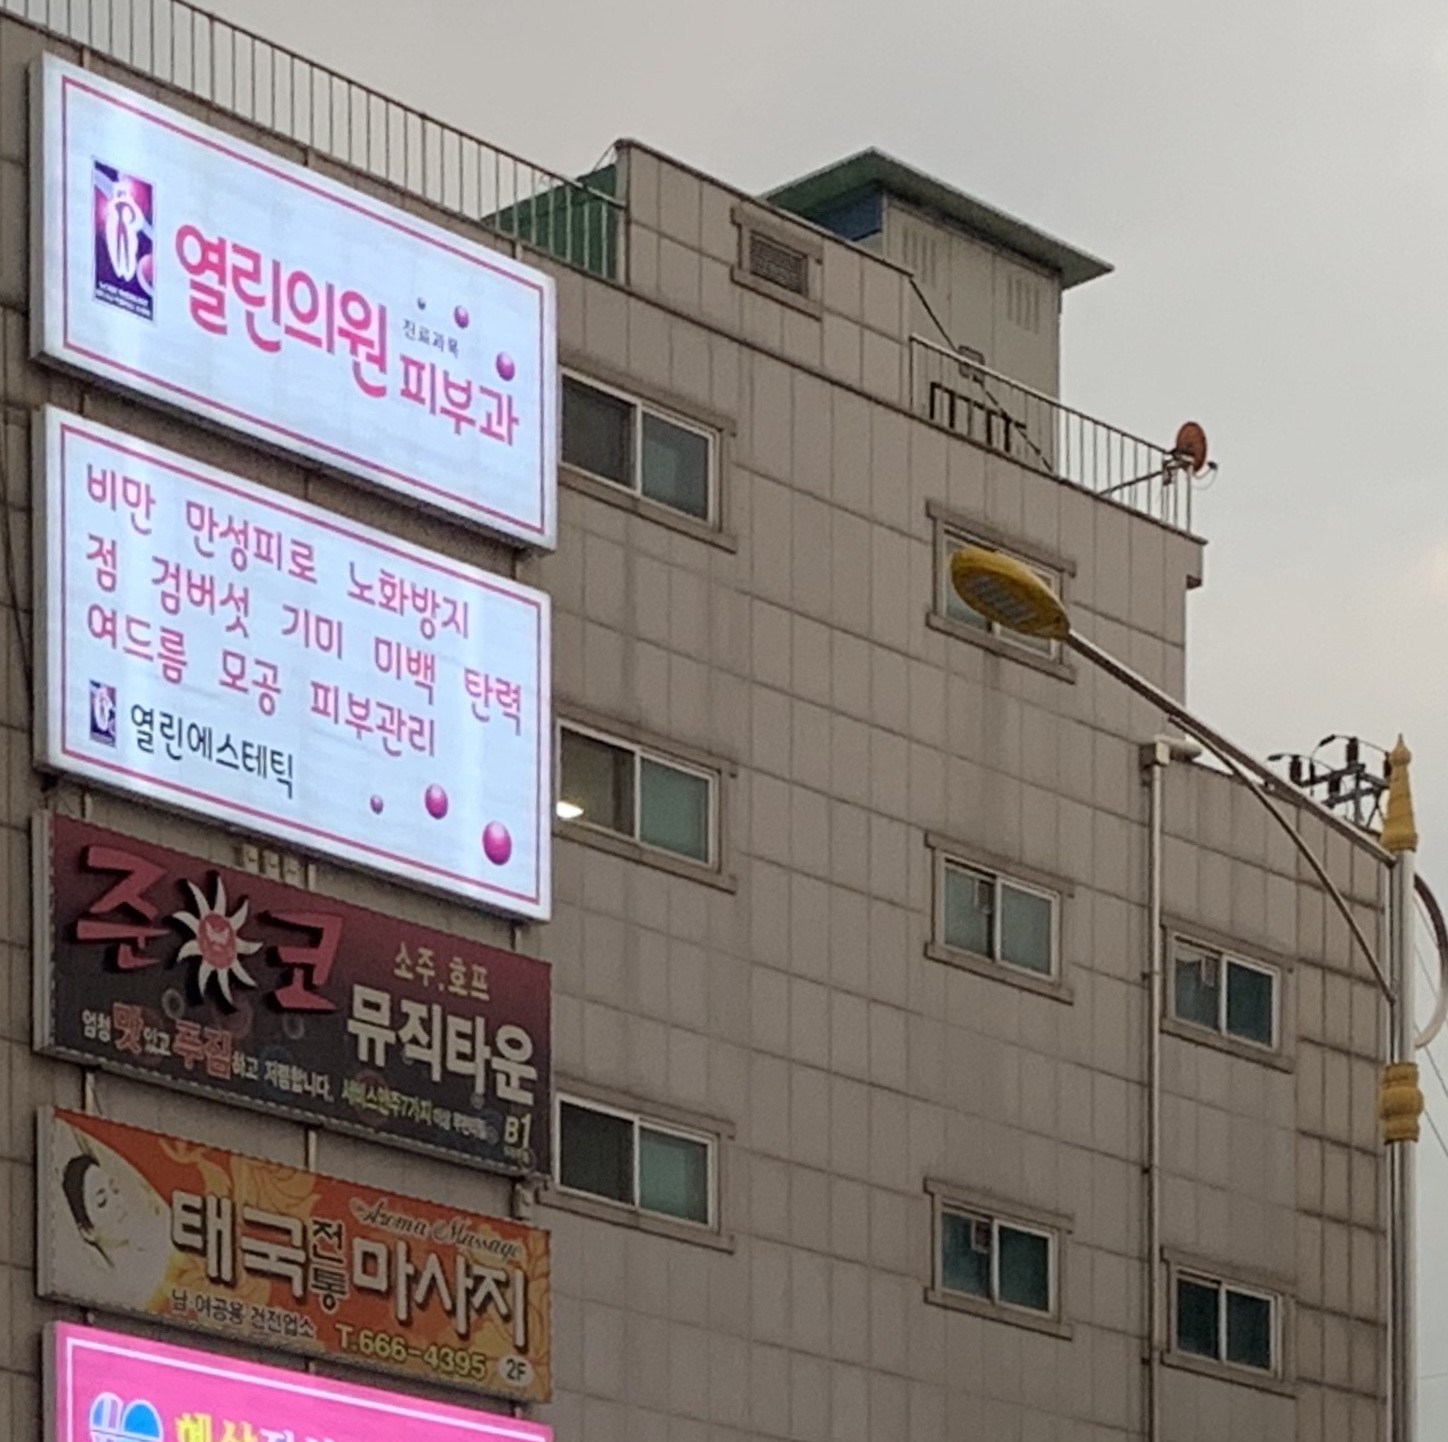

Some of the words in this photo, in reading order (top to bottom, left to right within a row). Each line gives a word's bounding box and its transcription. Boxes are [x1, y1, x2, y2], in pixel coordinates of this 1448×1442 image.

[175, 223, 388, 398] 열린의원
[402, 319, 460, 359] 진료과목
[400, 354, 519, 447] 피부과
[87, 463, 156, 536] 비만
[186, 500, 317, 584] 만성피로
[348, 561, 469, 641] 노화방지
[87, 533, 118, 593] 점
[152, 556, 250, 639] 검버섯
[281, 604, 344, 660] 기미
[374, 636, 437, 706] 미백
[465, 667, 522, 737] 탄력
[87, 603, 188, 684] 여드름
[219, 649, 282, 717] 모공
[310, 680, 436, 758] 피부관리
[130, 702, 294, 800] 열린에스테틱
[348, 983, 538, 1106] 뮤직타운
[505, 1113, 531, 1149] B1
[171, 1191, 309, 1303] 태국
[312, 1218, 350, 1312] 전통
[434, 1216, 527, 1263] Massage
[250, 1306, 317, 1341] 건전업소
[353, 1239, 529, 1355] 마사지
[336, 1323, 488, 1383] T.666-4395
[505, 1358, 528, 1383] 2F
